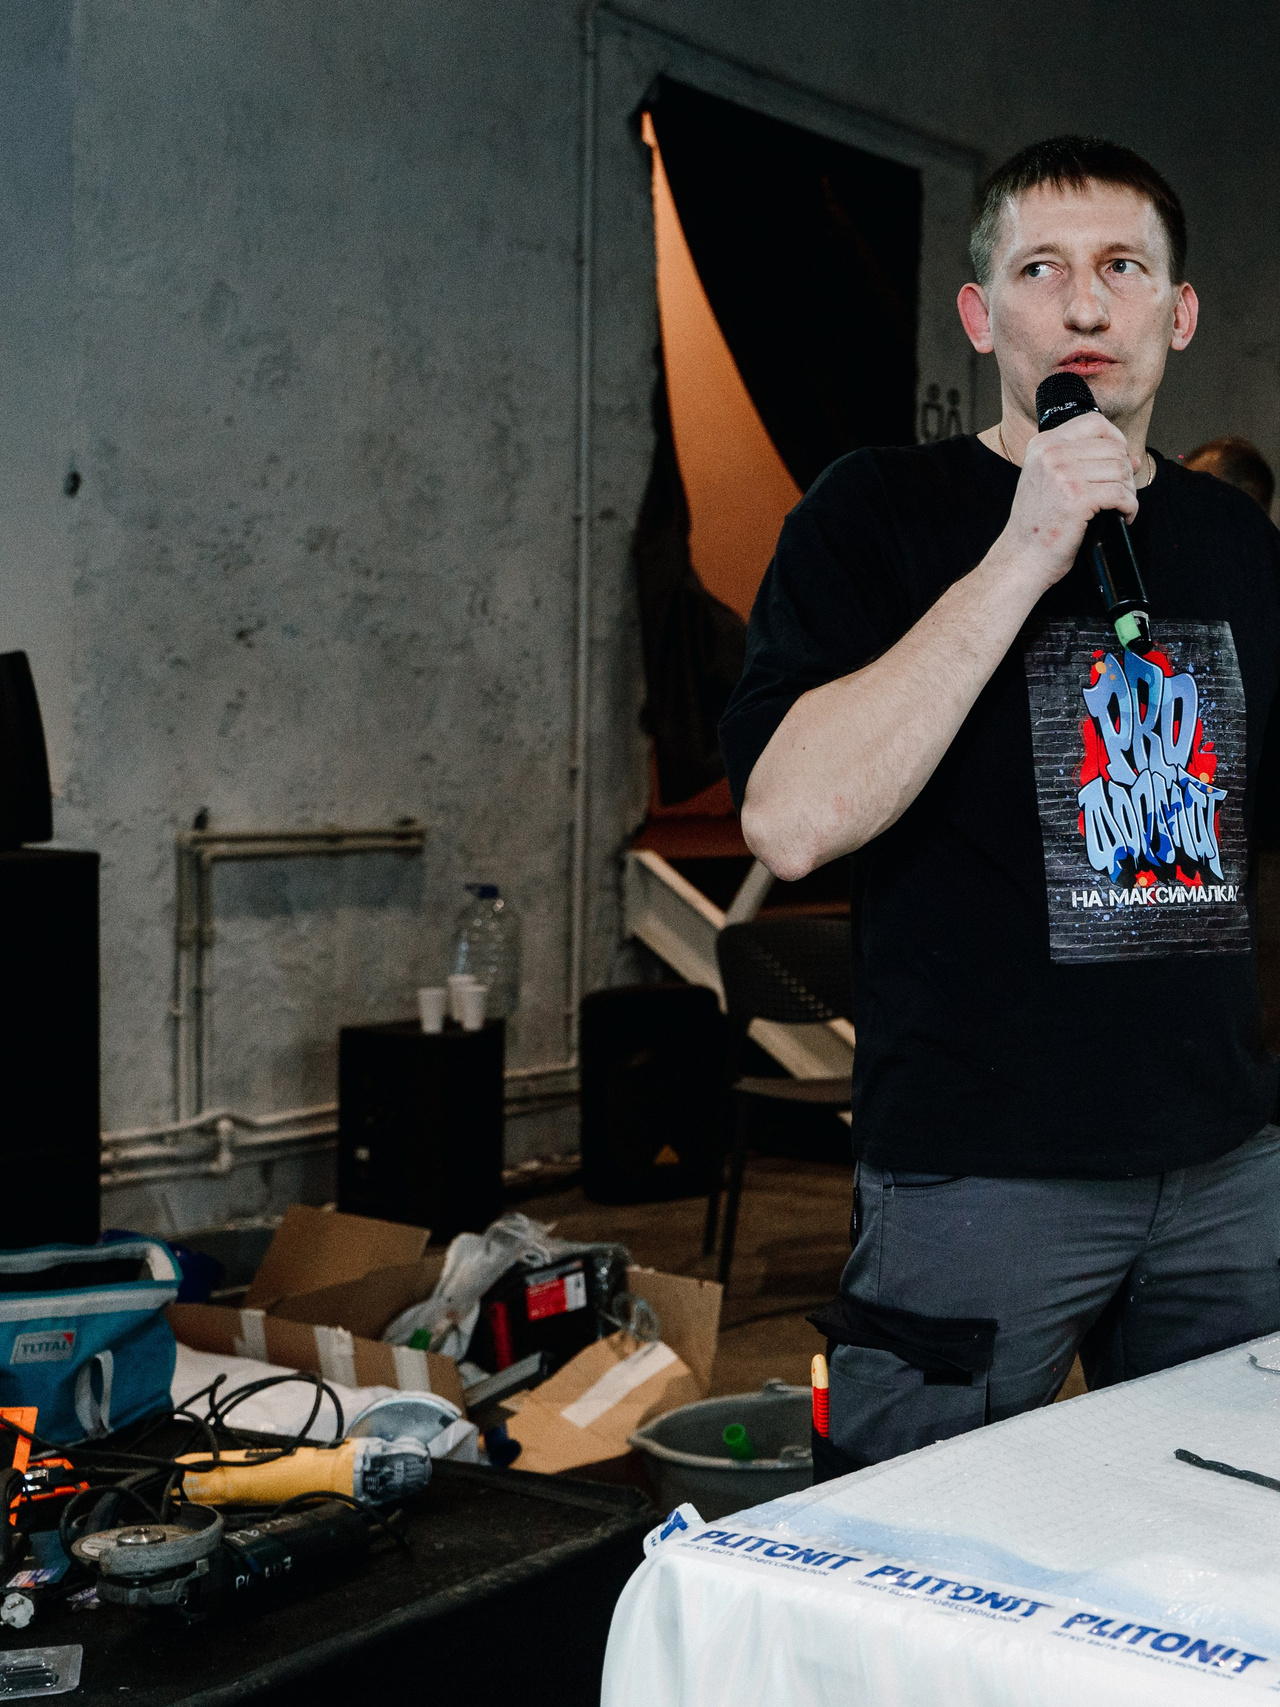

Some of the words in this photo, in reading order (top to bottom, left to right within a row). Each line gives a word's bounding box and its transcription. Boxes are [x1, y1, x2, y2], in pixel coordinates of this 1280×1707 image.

[1082, 650, 1199, 783] PRO
[1071, 890, 1104, 908] НА
[690, 1529, 864, 1571] PLITONIT
[736, 1553, 832, 1578] ПРОФЕССИОНАЛОМ
[864, 1564, 1055, 1618] PLITONIT
[1060, 1612, 1270, 1674] PLITONIT
